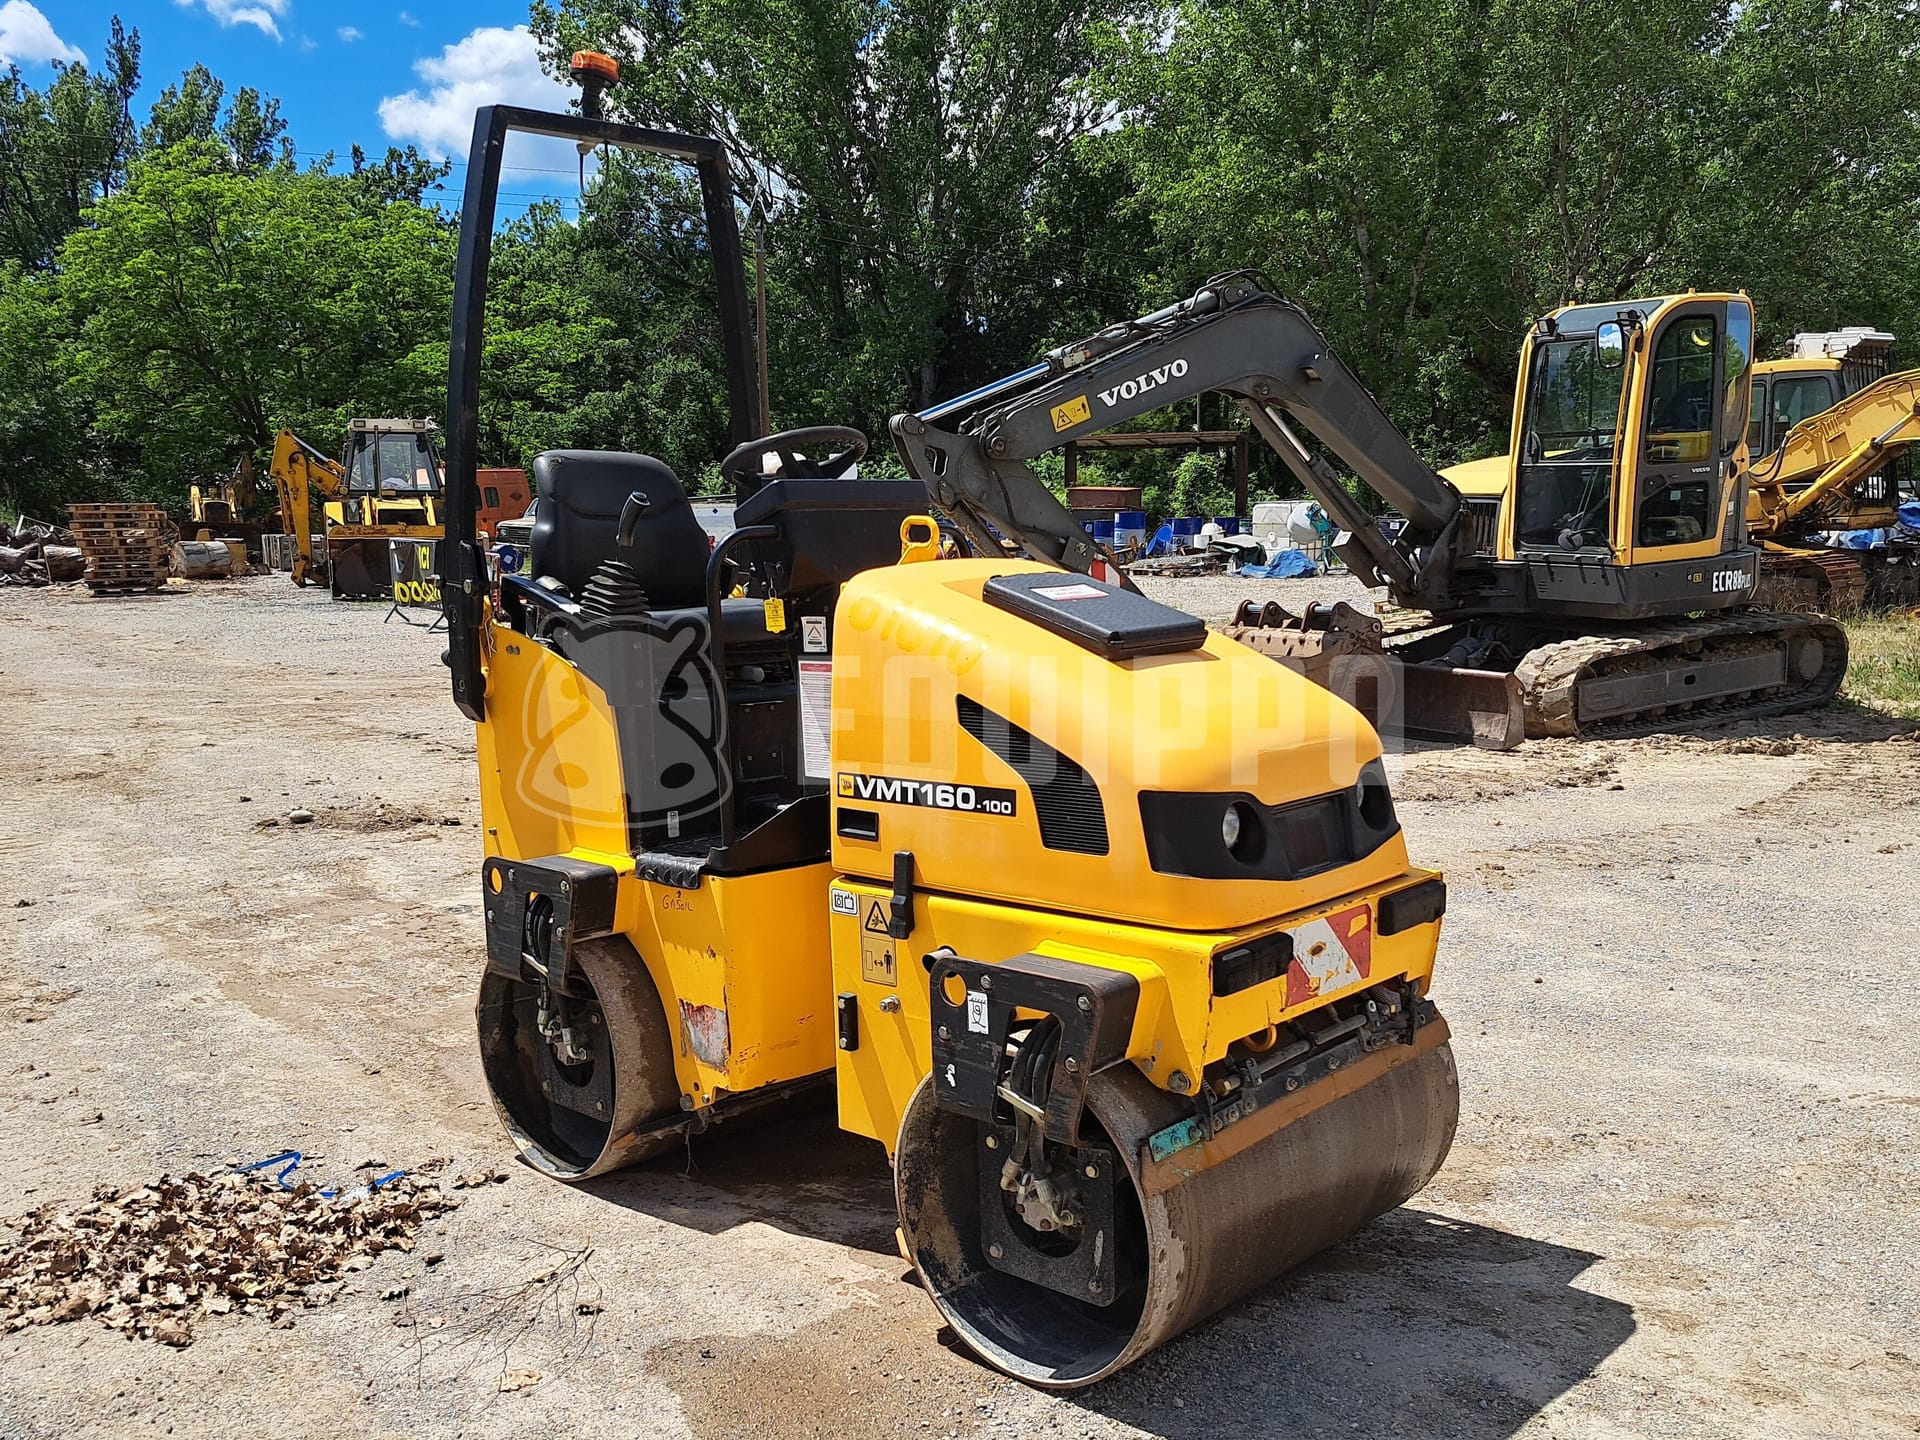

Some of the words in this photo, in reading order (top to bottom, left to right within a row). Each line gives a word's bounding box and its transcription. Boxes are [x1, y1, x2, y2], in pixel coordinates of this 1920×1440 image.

[1096, 359, 1188, 407] VOLVO
[418, 546, 430, 569] ICI
[855, 776, 1012, 814] VMT160-100
